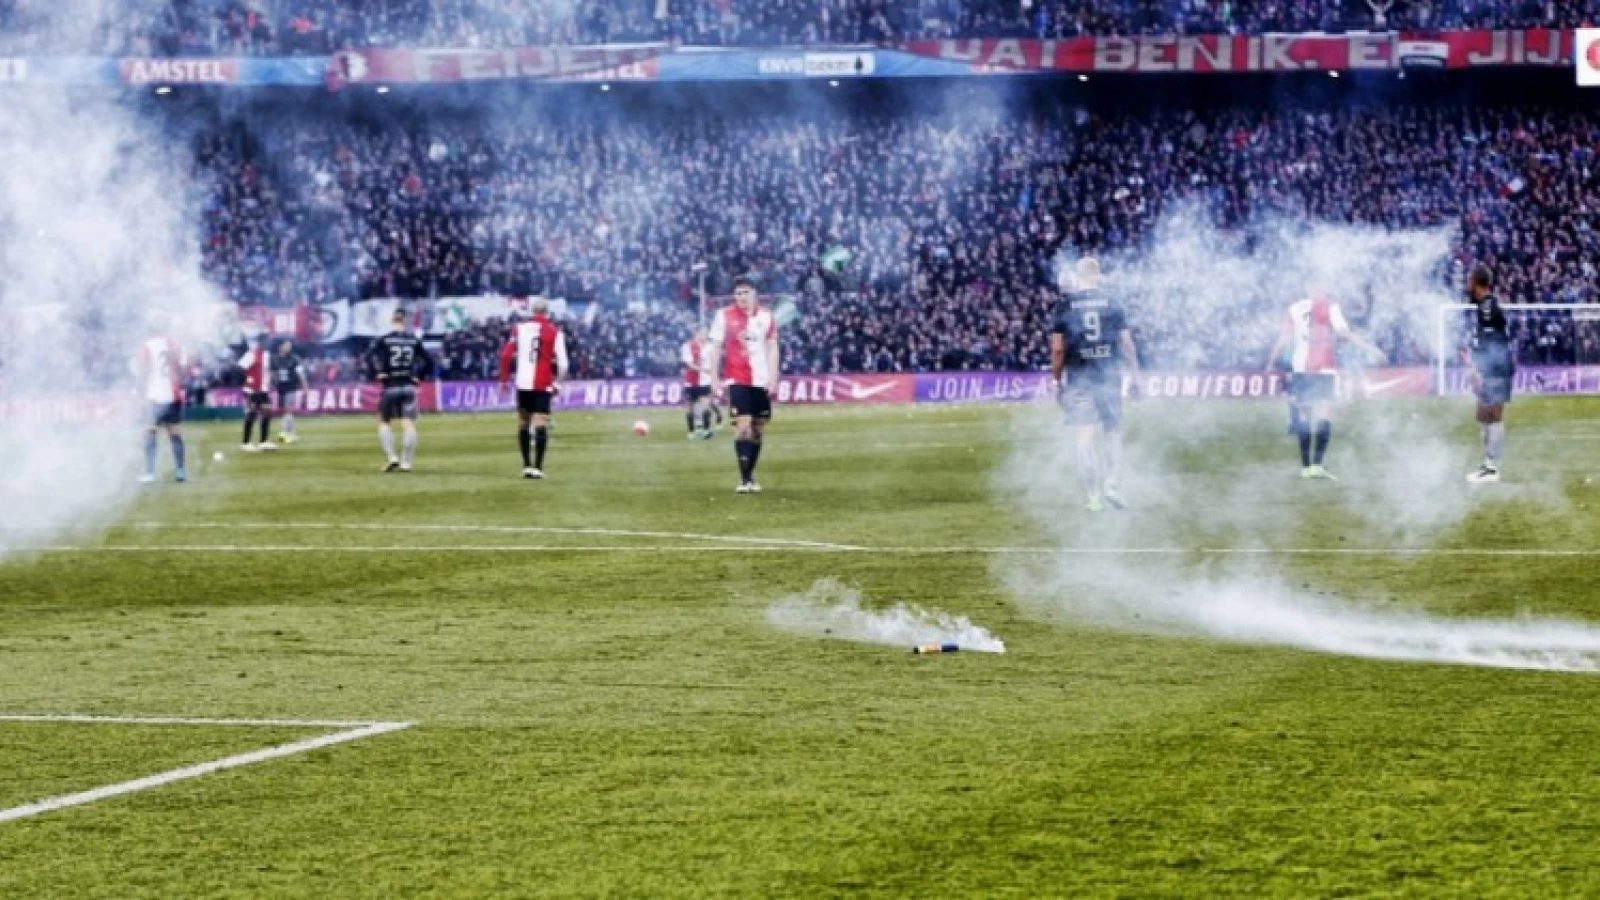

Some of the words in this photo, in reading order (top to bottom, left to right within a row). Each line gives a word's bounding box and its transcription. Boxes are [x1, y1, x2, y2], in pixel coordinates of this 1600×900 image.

[1094, 34, 1233, 71] BEN
[129, 60, 228, 83] AMSTEL
[1084, 311, 1101, 342] 9
[389, 345, 414, 367] 23
[928, 375, 982, 399] JOIN
[994, 374, 1024, 398] US
